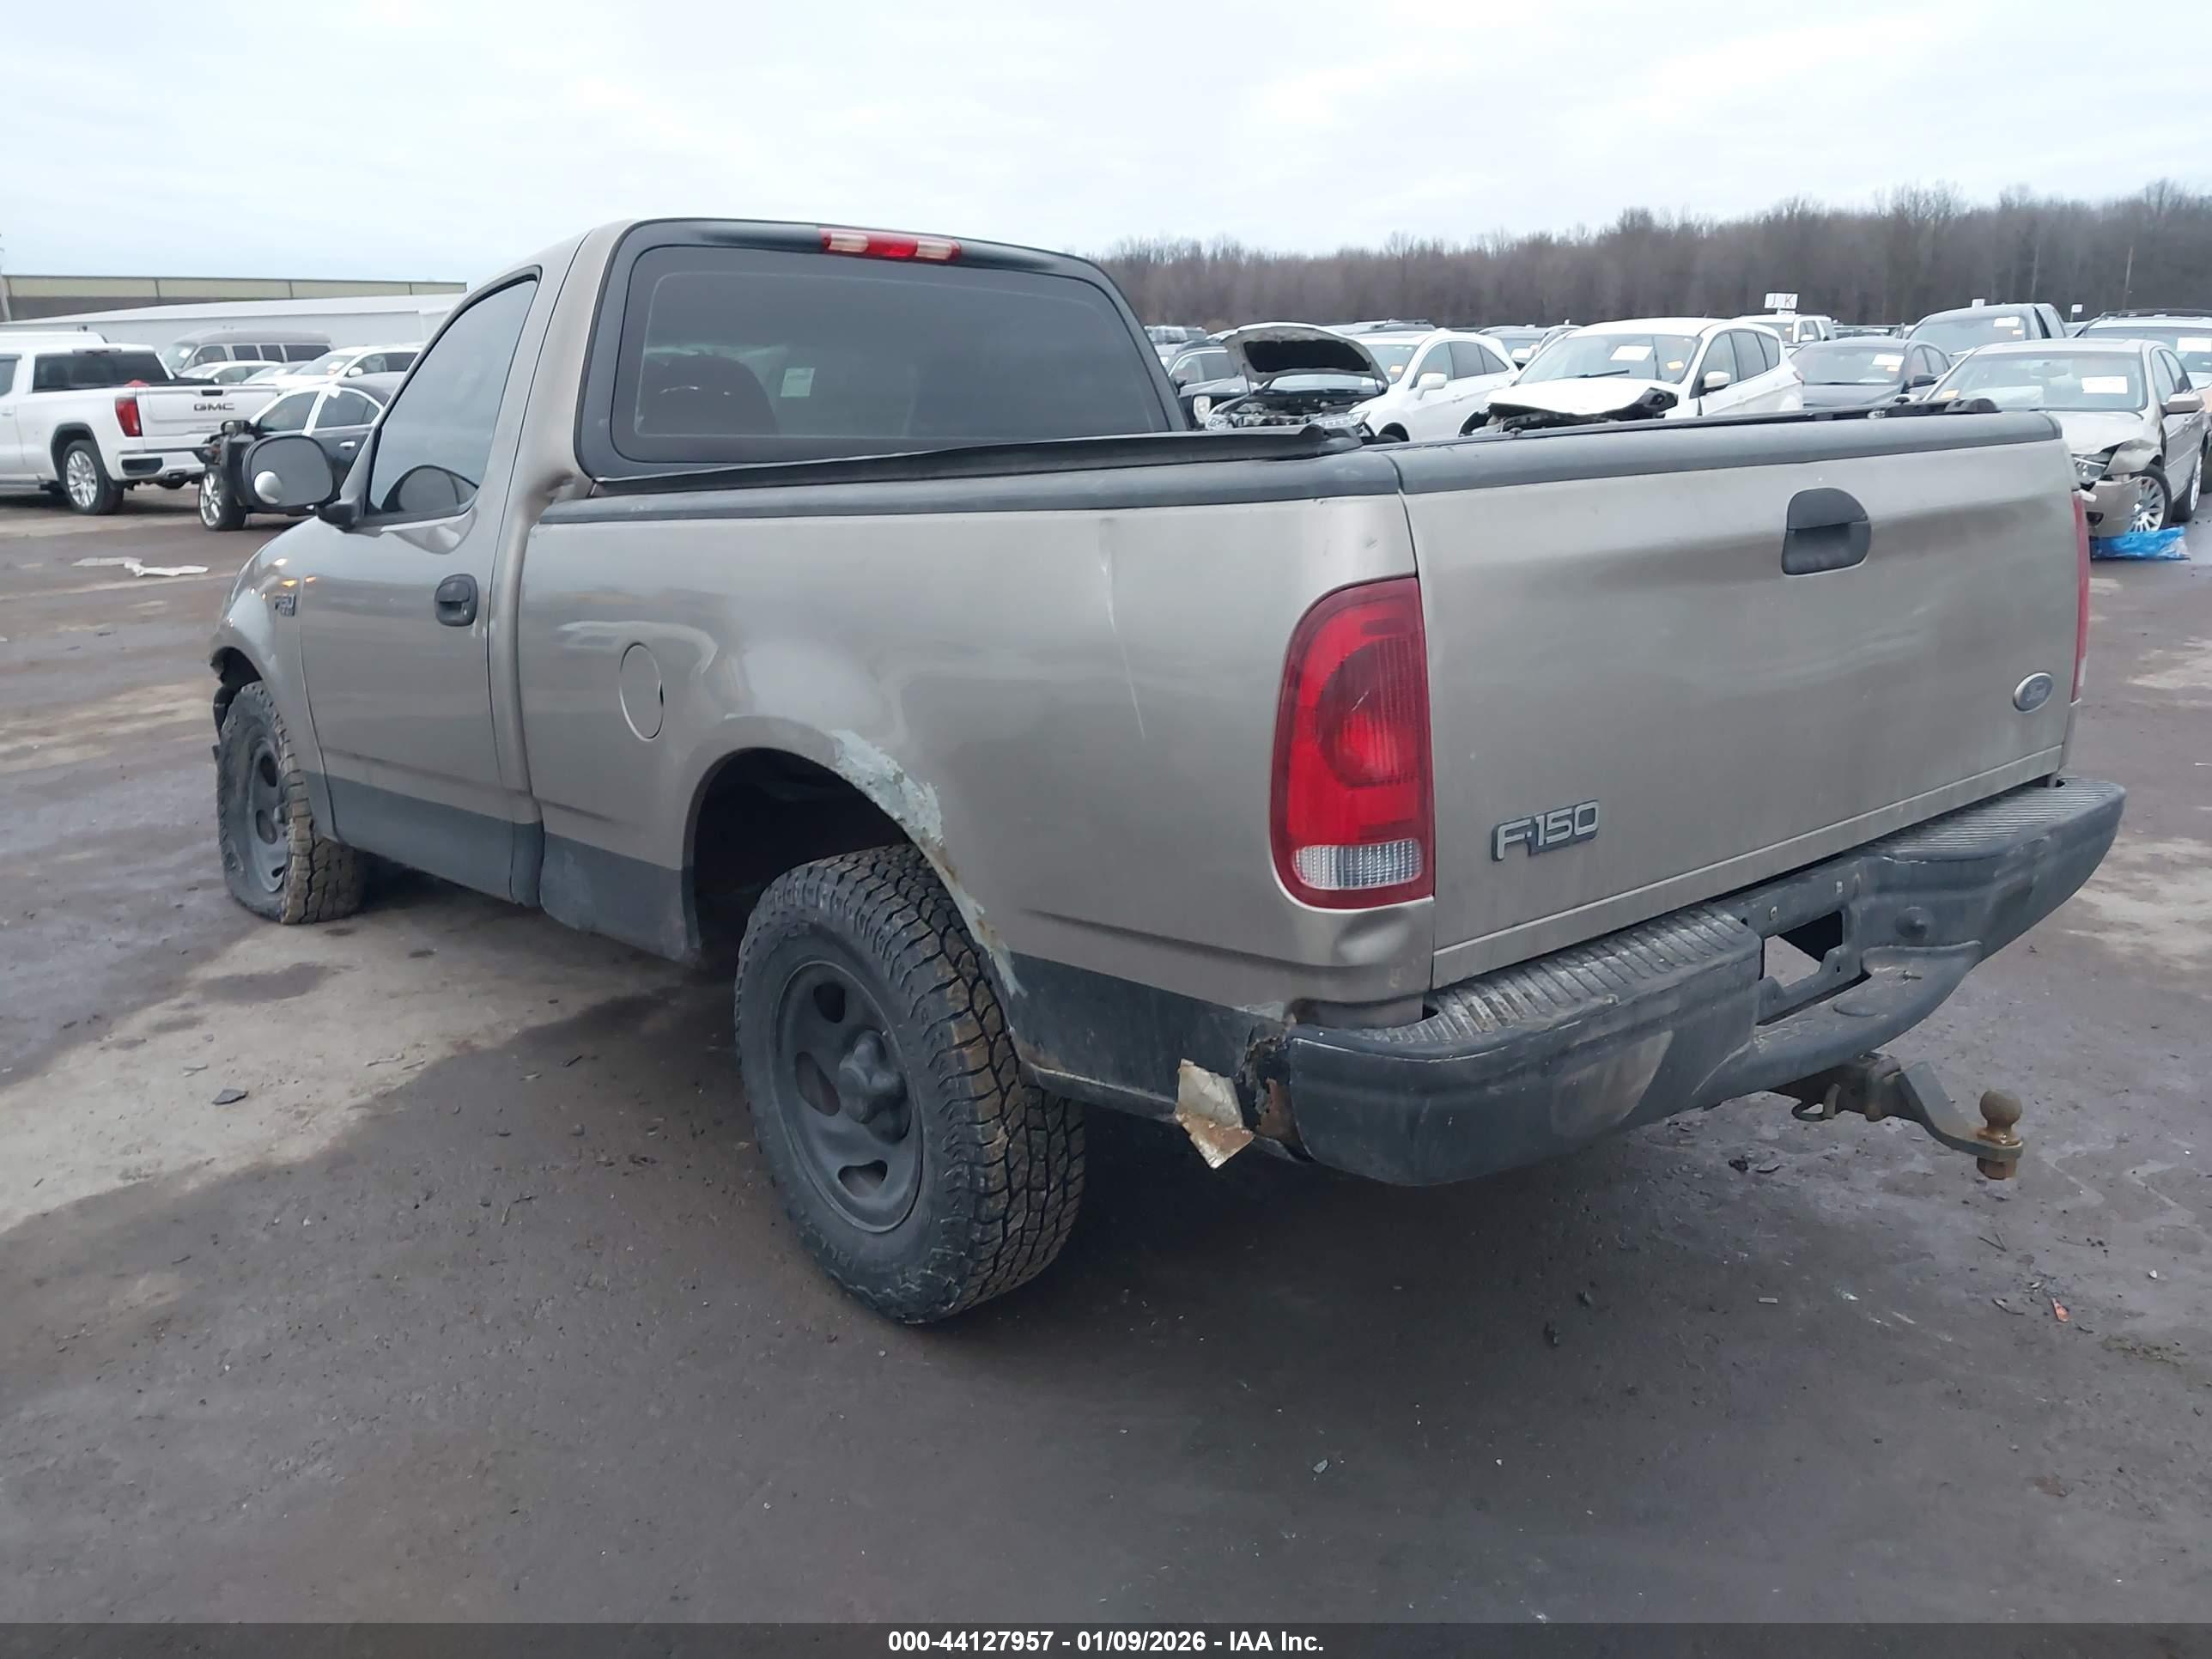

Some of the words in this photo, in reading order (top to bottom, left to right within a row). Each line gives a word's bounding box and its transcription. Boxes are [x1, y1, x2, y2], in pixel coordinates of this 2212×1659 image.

[1784, 295, 1794, 307] K
[194, 402, 234, 411] GMC
[1494, 800, 1599, 860] F-150
